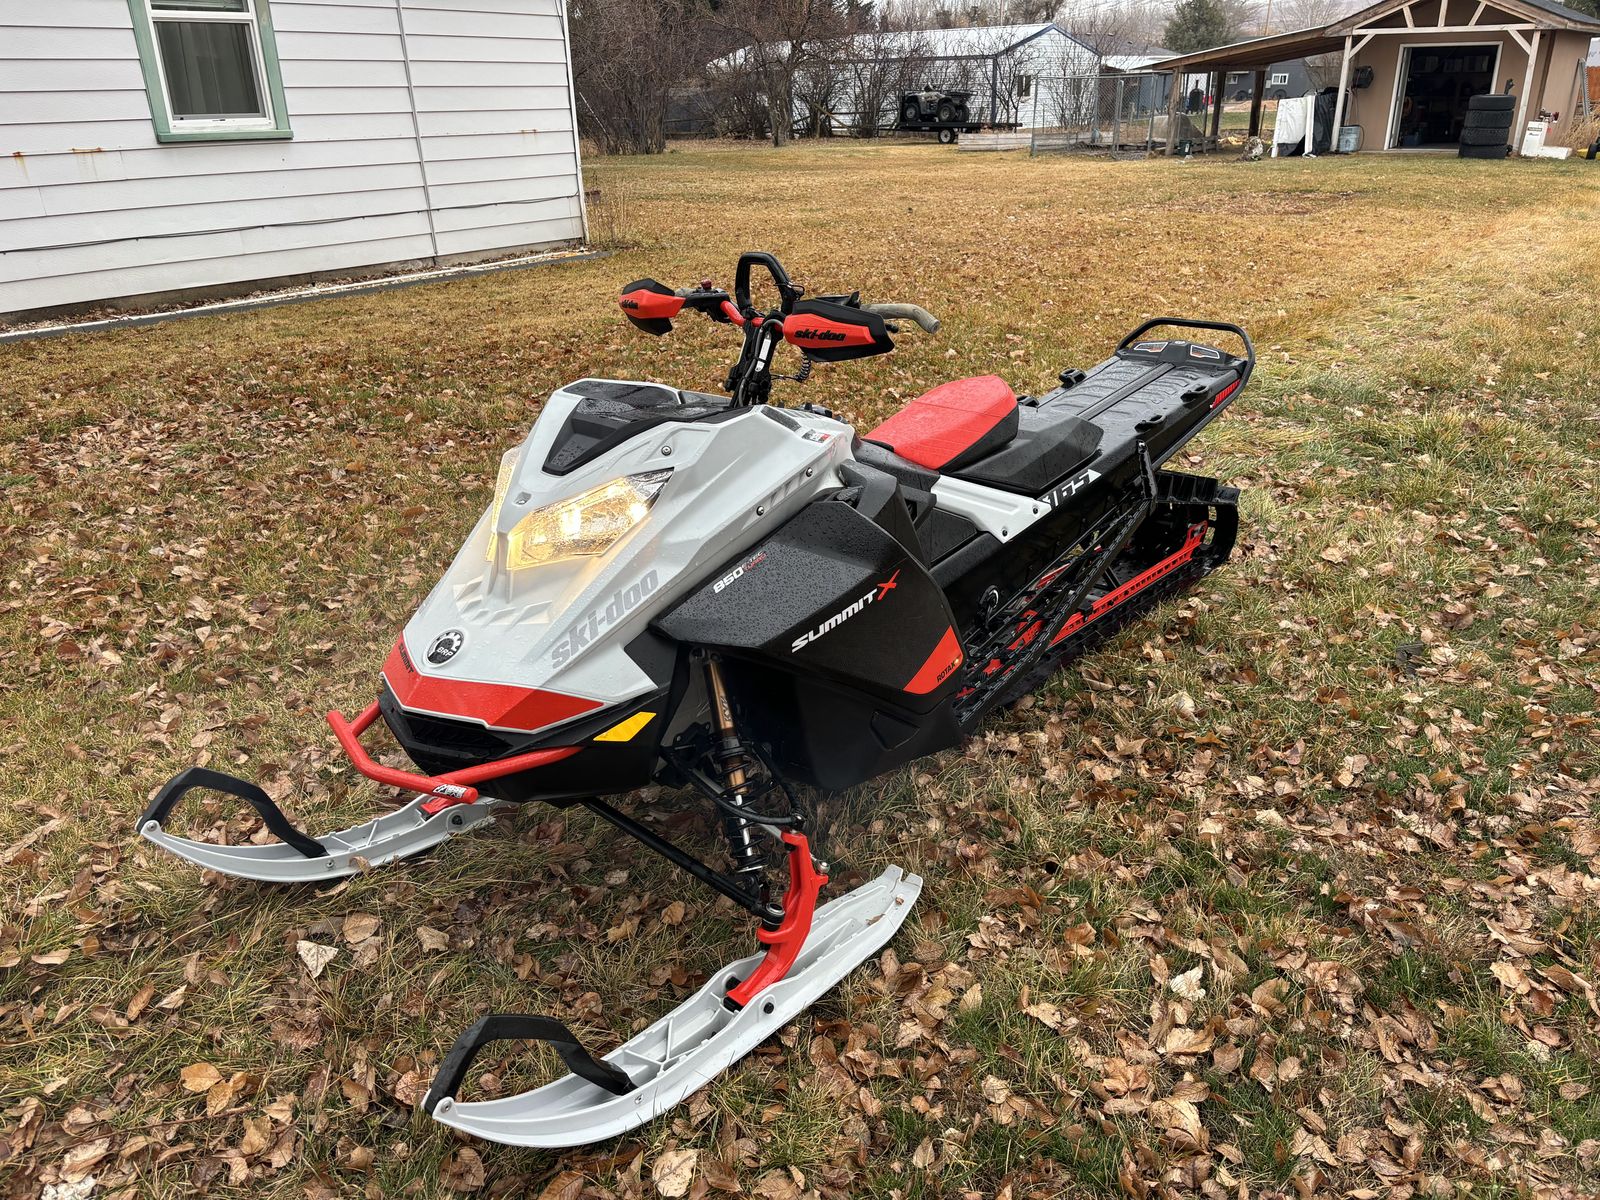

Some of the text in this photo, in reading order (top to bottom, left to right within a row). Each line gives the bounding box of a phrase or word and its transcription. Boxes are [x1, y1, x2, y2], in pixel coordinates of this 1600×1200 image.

[794, 328, 847, 342] ski-doo
[713, 566, 744, 593] 850
[551, 569, 659, 669] ski-doo
[791, 569, 901, 653] SUMMIT X
[436, 646, 454, 657] BRP
[936, 660, 956, 682] ROTAX
